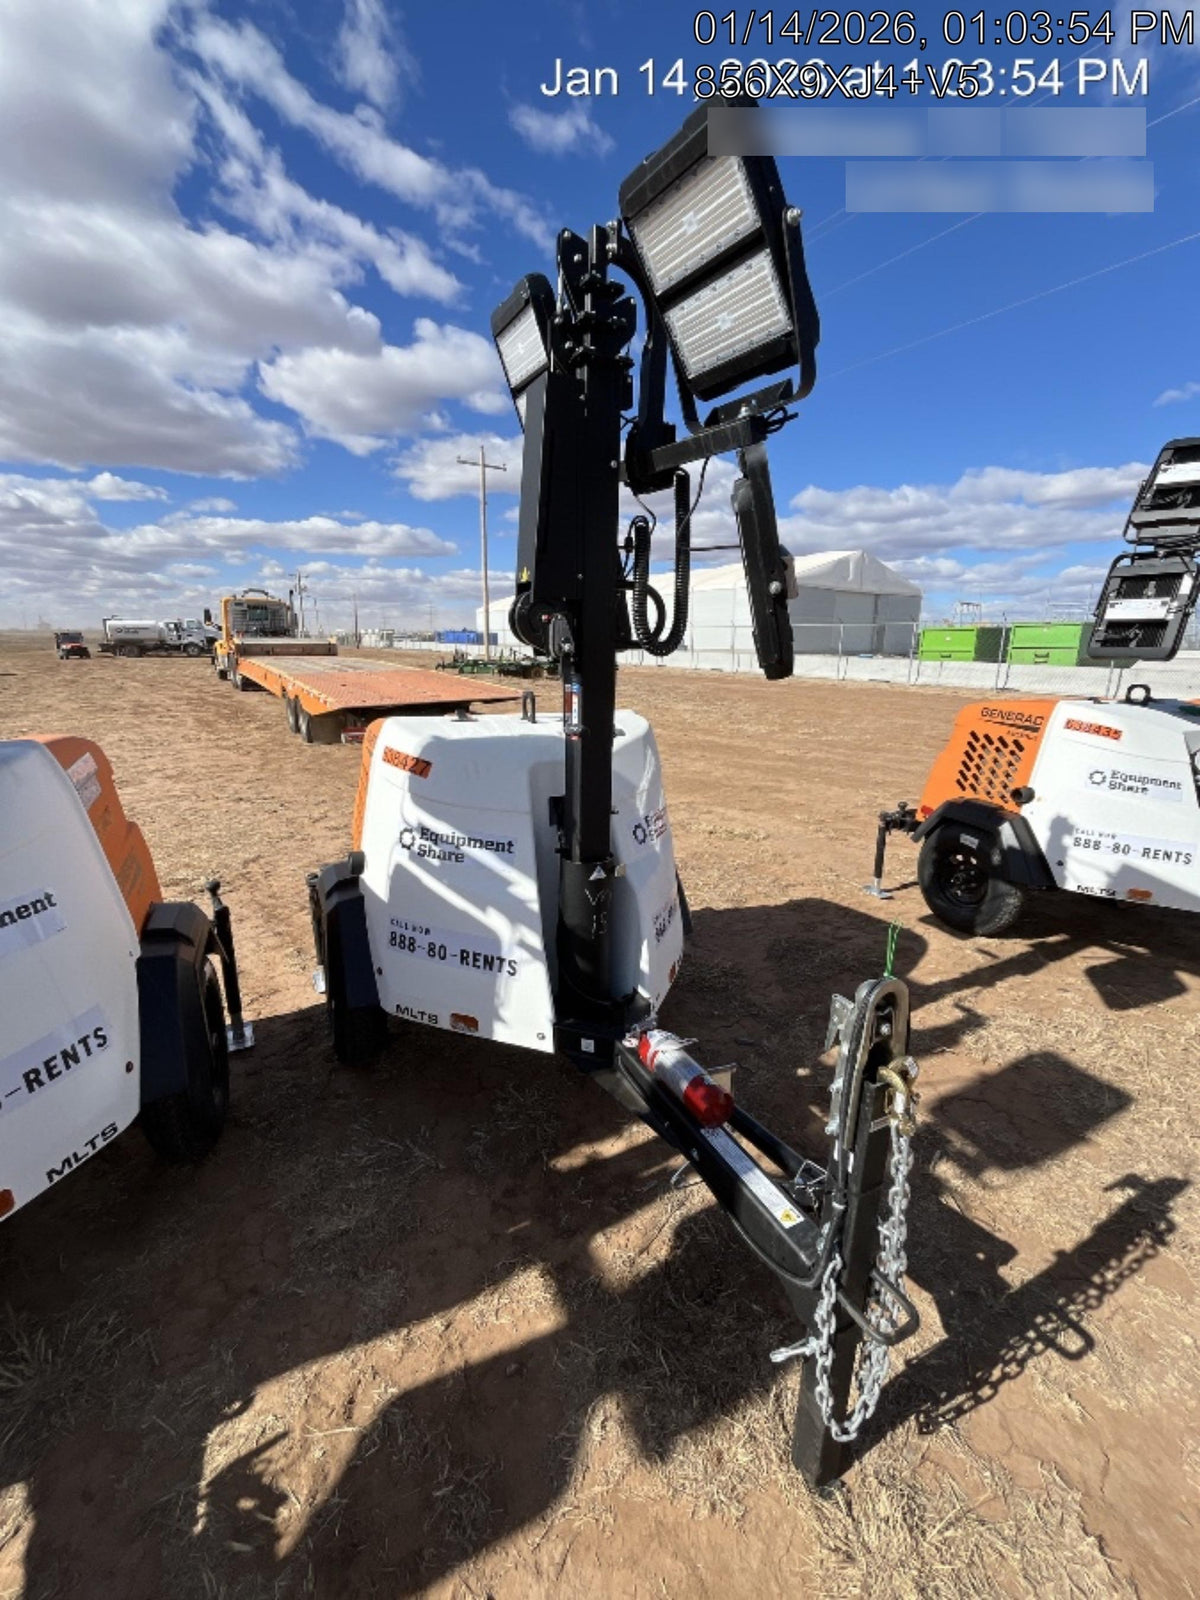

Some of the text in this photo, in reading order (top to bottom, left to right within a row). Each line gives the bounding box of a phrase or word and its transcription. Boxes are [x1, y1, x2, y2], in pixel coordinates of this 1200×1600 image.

[981, 707, 1044, 726] GENERAC
[1110, 770, 1182, 789] Equipment
[420, 826, 514, 853] Equipment
[417, 844, 464, 862] Share
[46, 1122, 118, 1183] MLTS
